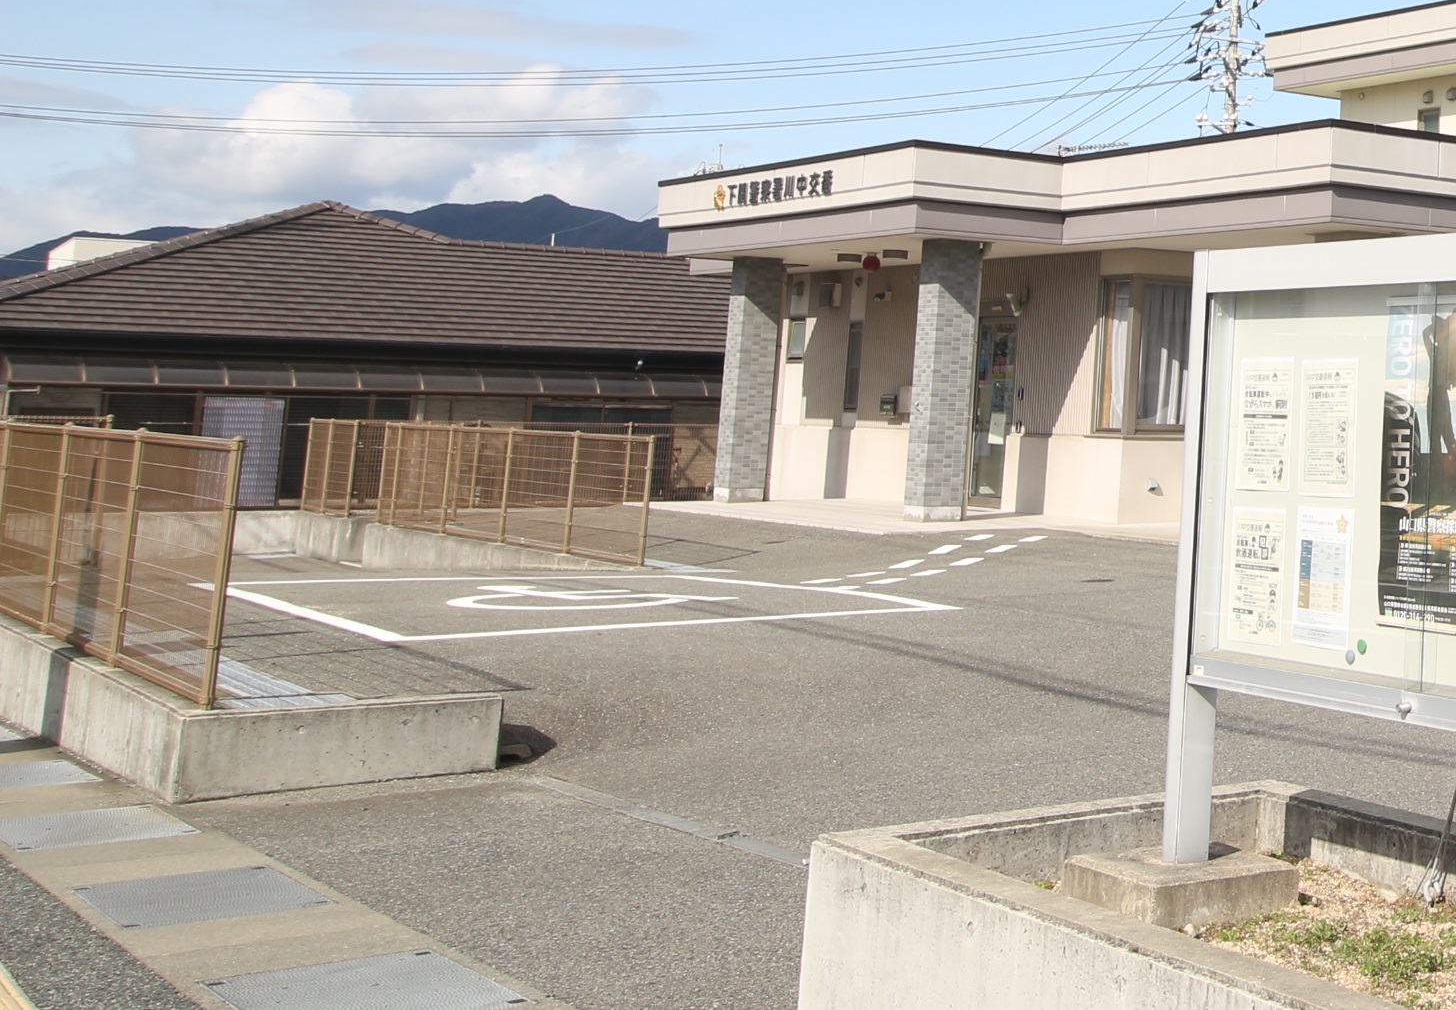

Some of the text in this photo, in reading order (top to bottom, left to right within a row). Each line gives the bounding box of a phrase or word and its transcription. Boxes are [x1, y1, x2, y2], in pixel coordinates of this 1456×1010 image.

[728, 170, 833, 207] 下関警察署川中交番
[1386, 428, 1411, 507] HERO
